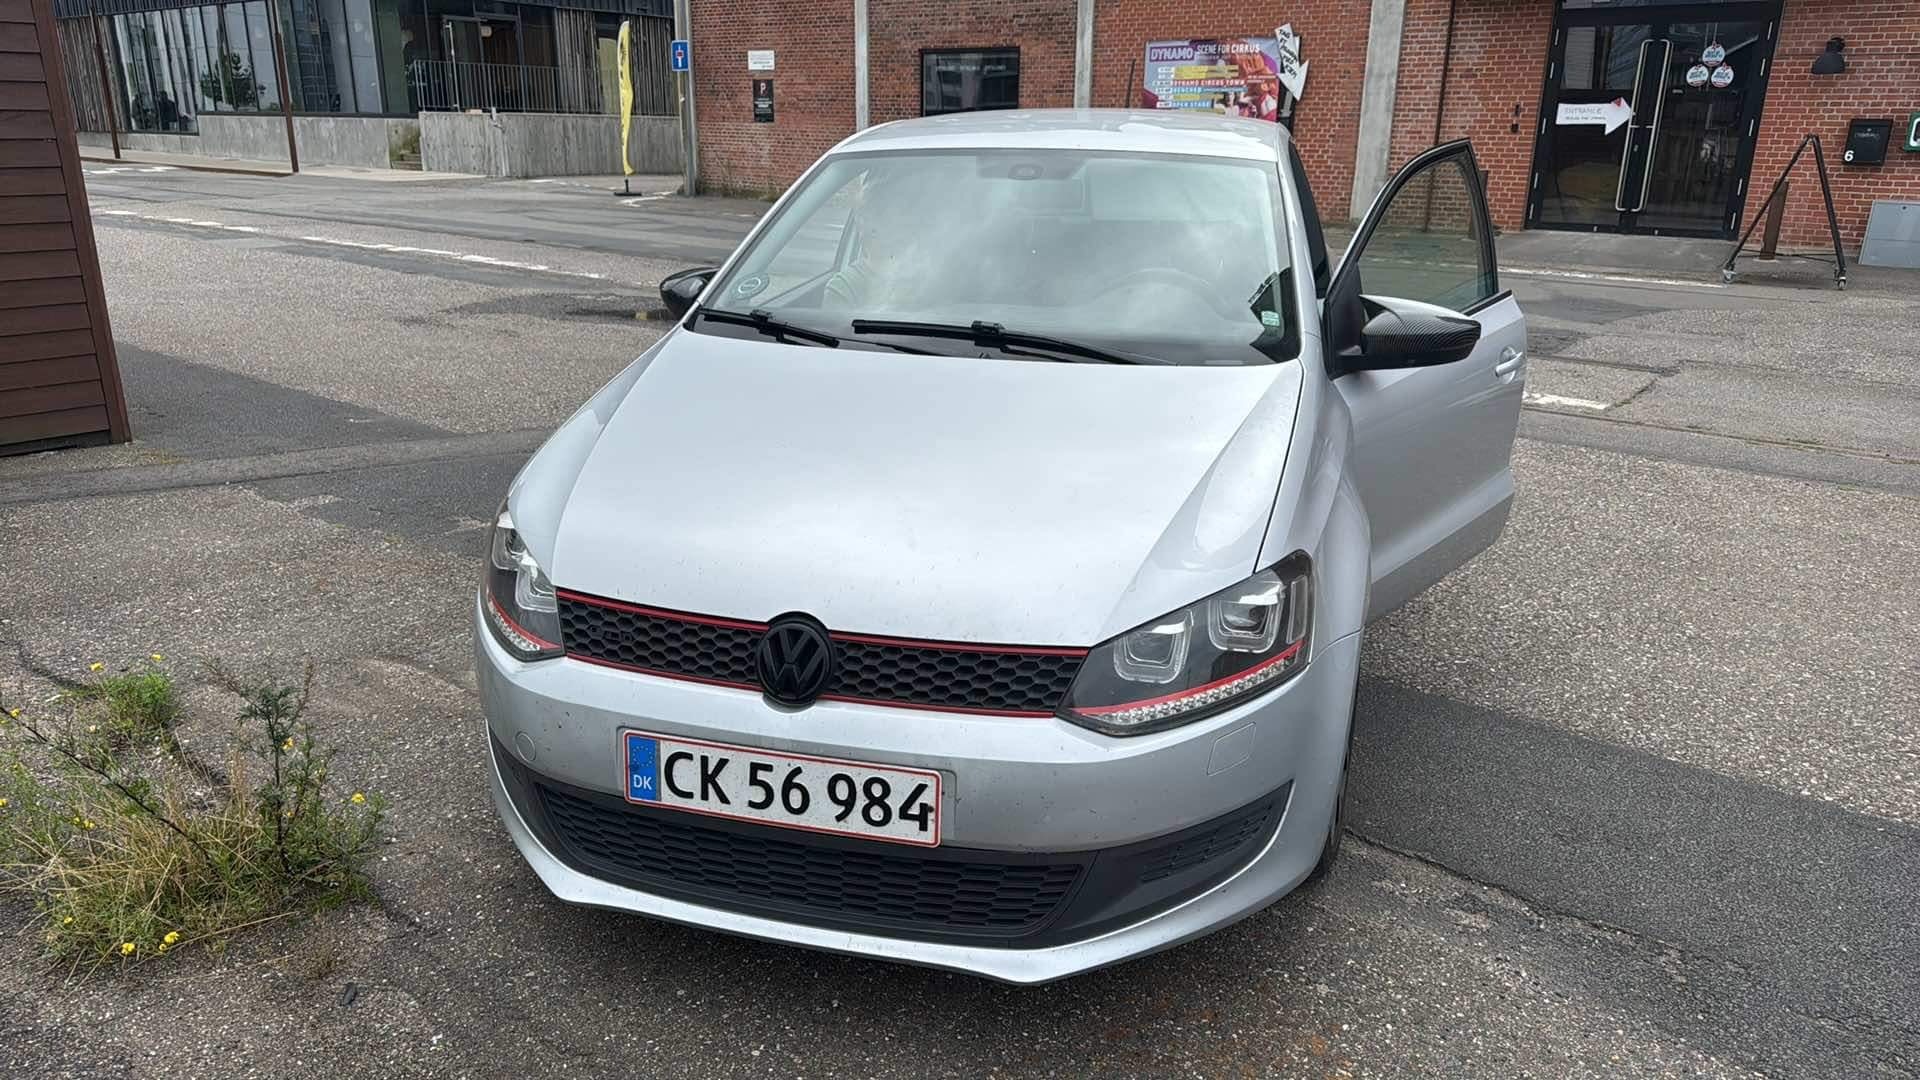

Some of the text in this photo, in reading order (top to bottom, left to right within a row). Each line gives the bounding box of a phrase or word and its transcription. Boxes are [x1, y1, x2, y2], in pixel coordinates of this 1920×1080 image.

[1151, 48, 1193, 60] DYNAMO
[1197, 45, 1216, 54] SCENE
[1218, 44, 1229, 54] FOR
[1231, 44, 1260, 54] CIRKUS
[1844, 149, 1855, 162] 6
[633, 773, 653, 791] DK
[663, 750, 931, 833] CK 56 984
